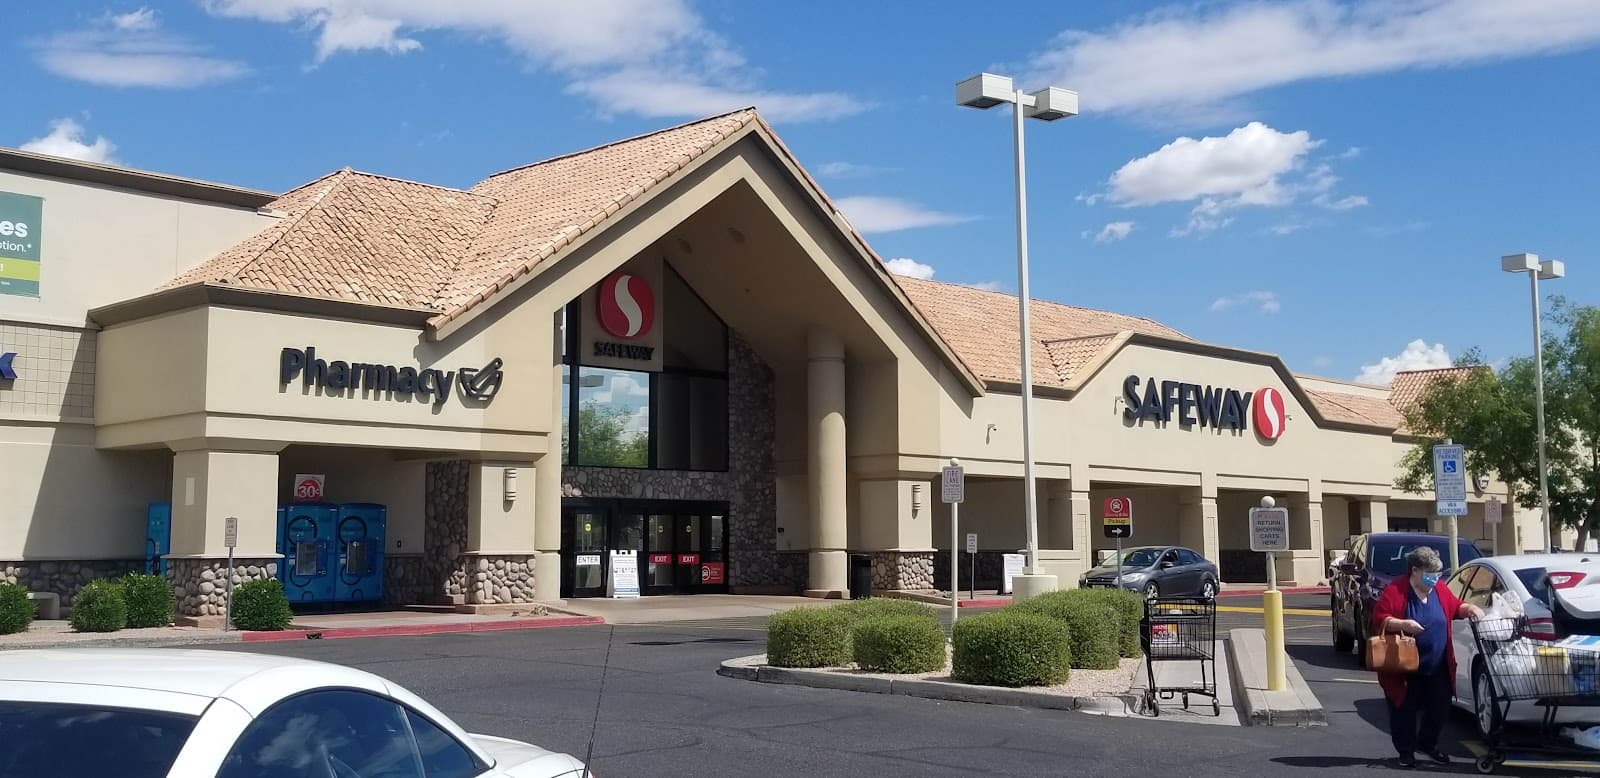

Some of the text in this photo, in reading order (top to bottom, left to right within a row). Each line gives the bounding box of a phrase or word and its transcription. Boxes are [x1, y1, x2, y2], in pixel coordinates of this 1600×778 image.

[593, 342, 655, 361] SAFEWAY
[280, 346, 455, 406] Pharmacy
[1122, 374, 1253, 431] SAFEWAY
[578, 556, 599, 564] ENTER
[654, 555, 668, 563] EXIT
[682, 555, 695, 563] EXIT
